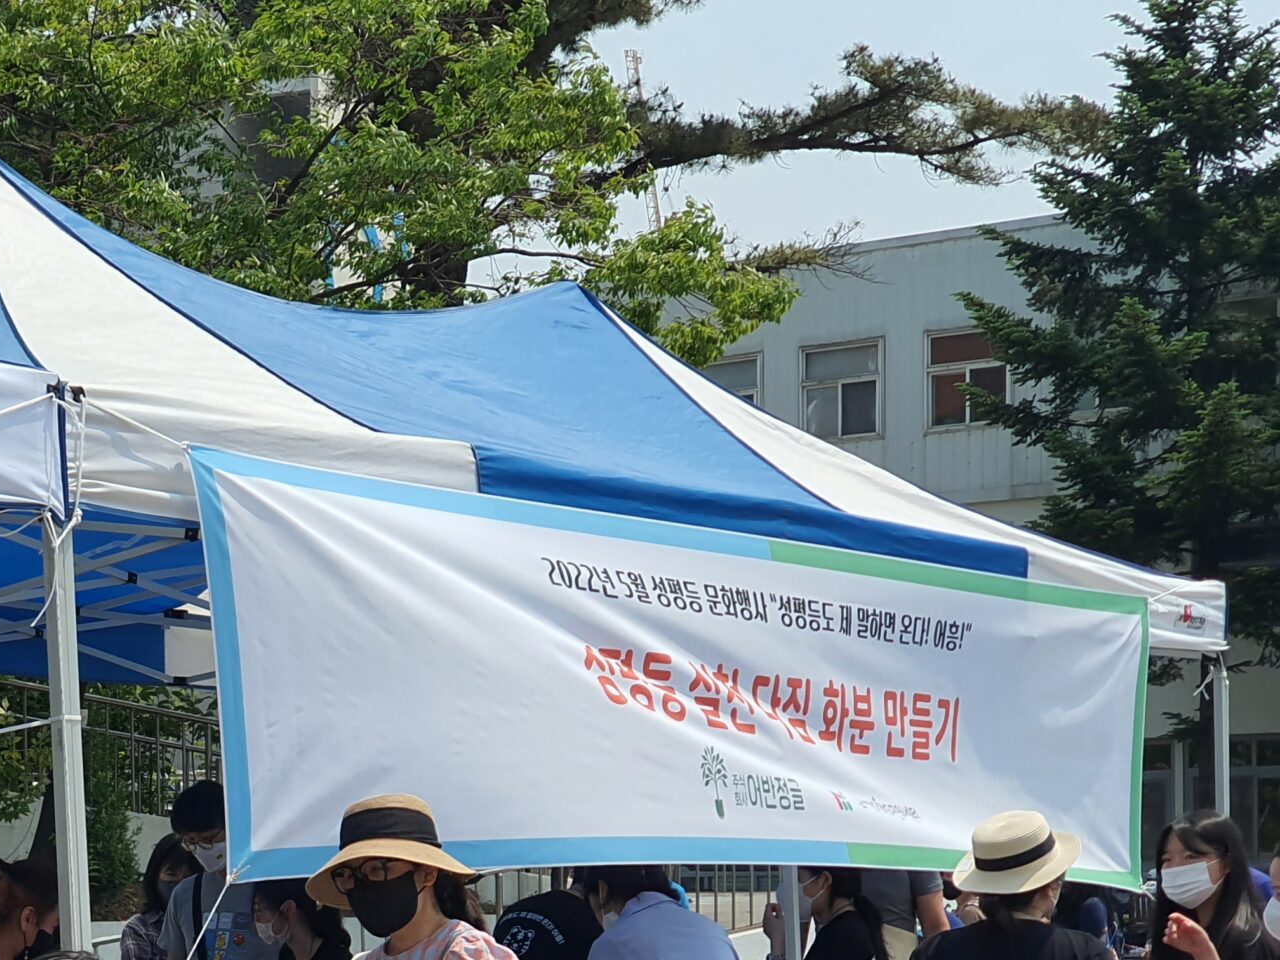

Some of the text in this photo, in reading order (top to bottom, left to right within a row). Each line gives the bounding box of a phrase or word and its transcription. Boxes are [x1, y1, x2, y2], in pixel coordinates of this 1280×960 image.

[541, 557, 972, 652] 2022년 5월 성평등 문화행사 "성평등도 제 말하면 온다! 어흥!"
[818, 679, 875, 755] 화분
[884, 689, 961, 763] 만들기
[747, 774, 805, 811] 어반정글
